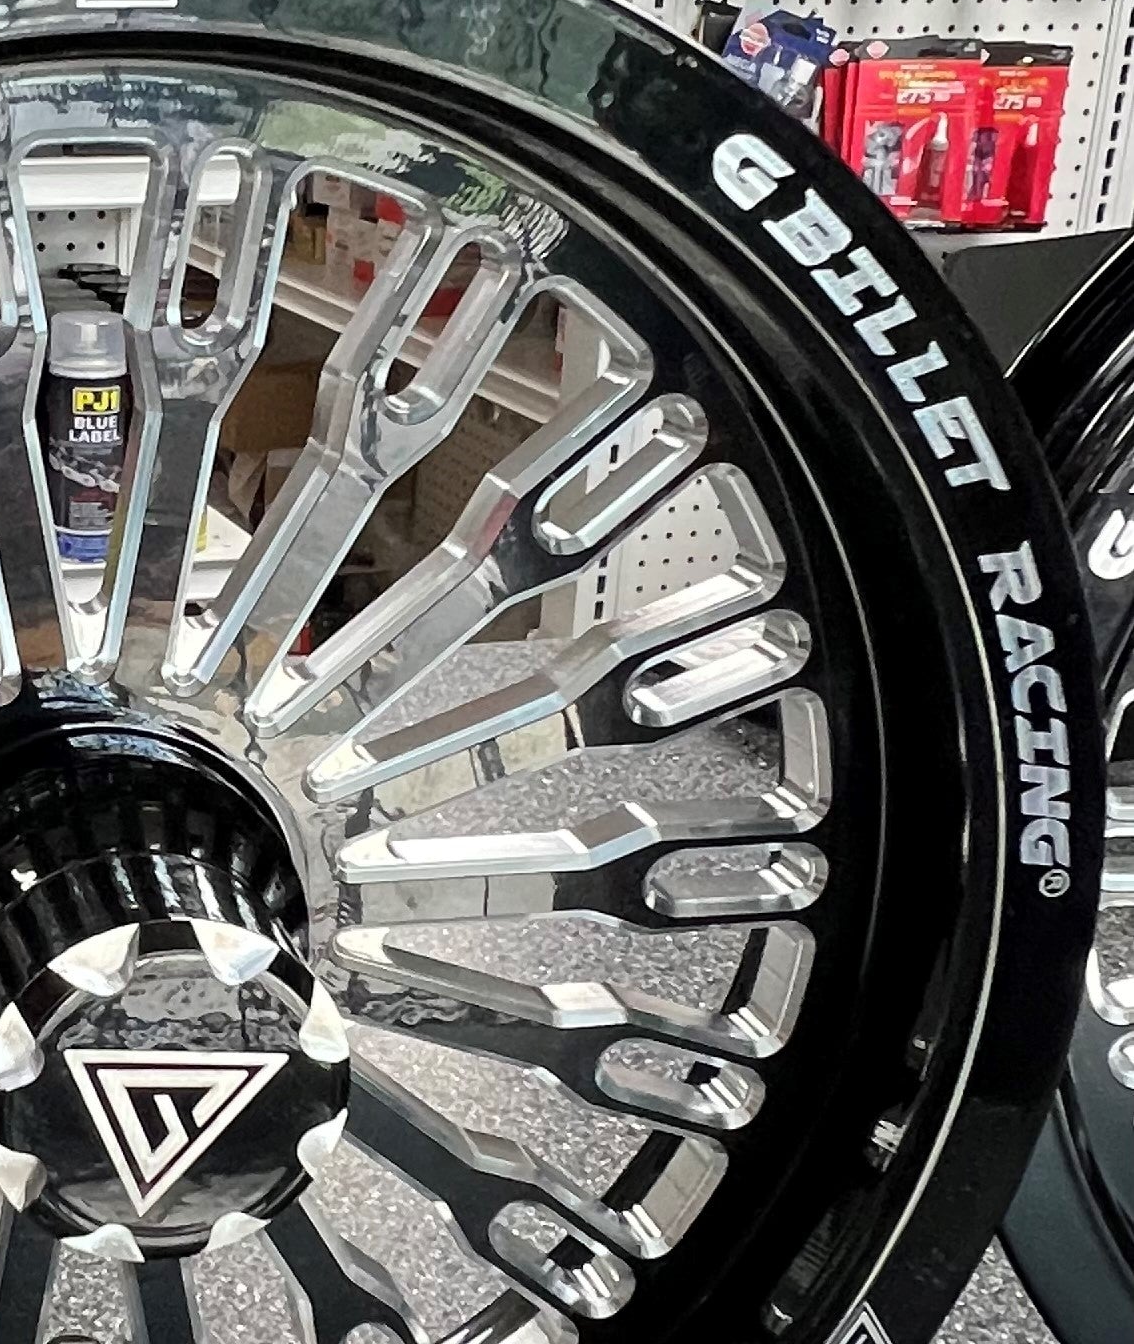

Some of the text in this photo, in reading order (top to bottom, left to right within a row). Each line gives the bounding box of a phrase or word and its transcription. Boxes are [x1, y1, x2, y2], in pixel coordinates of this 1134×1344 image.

[712, 133, 796, 211] G
[760, 187, 1012, 491] BILLET
[73, 415, 118, 430] BLUE
[68, 429, 121, 444] LABEL
